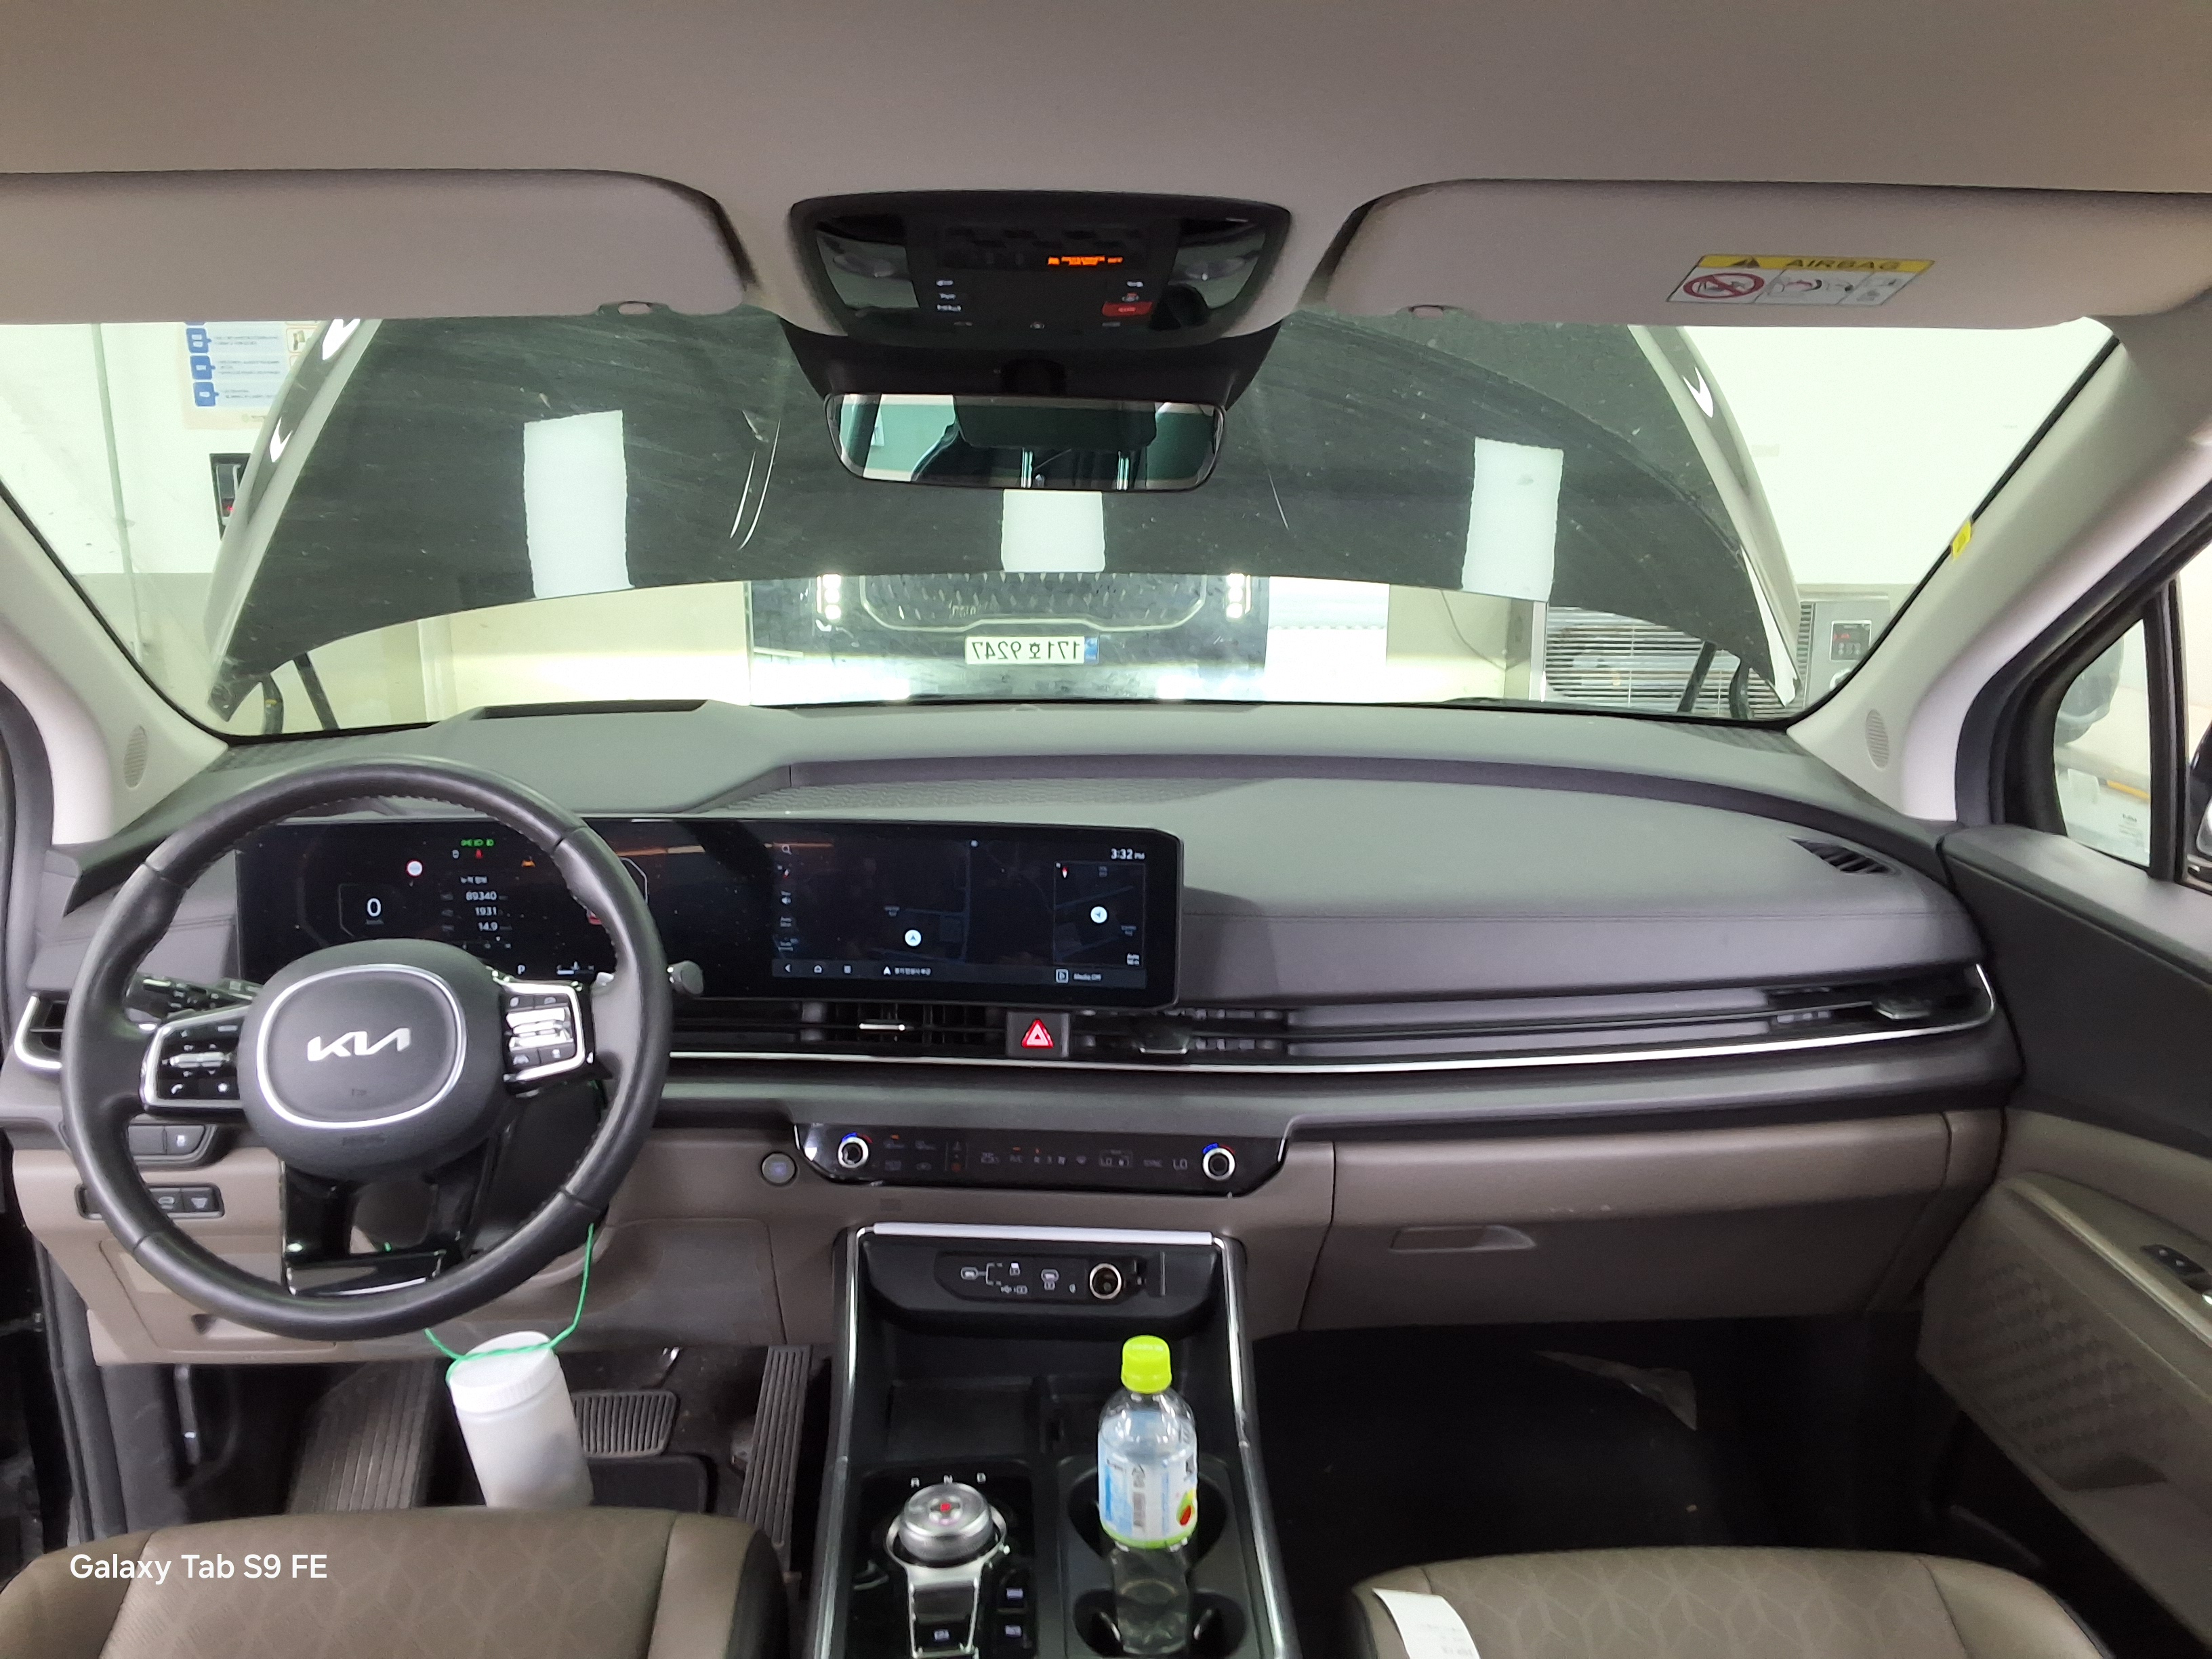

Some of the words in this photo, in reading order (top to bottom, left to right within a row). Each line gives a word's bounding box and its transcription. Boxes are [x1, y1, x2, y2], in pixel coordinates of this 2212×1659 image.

[1786, 259, 1900, 270] AIRBAG
[1111, 848, 1133, 860] 3:32
[367, 897, 382, 918] 0
[517, 964, 526, 975] P
